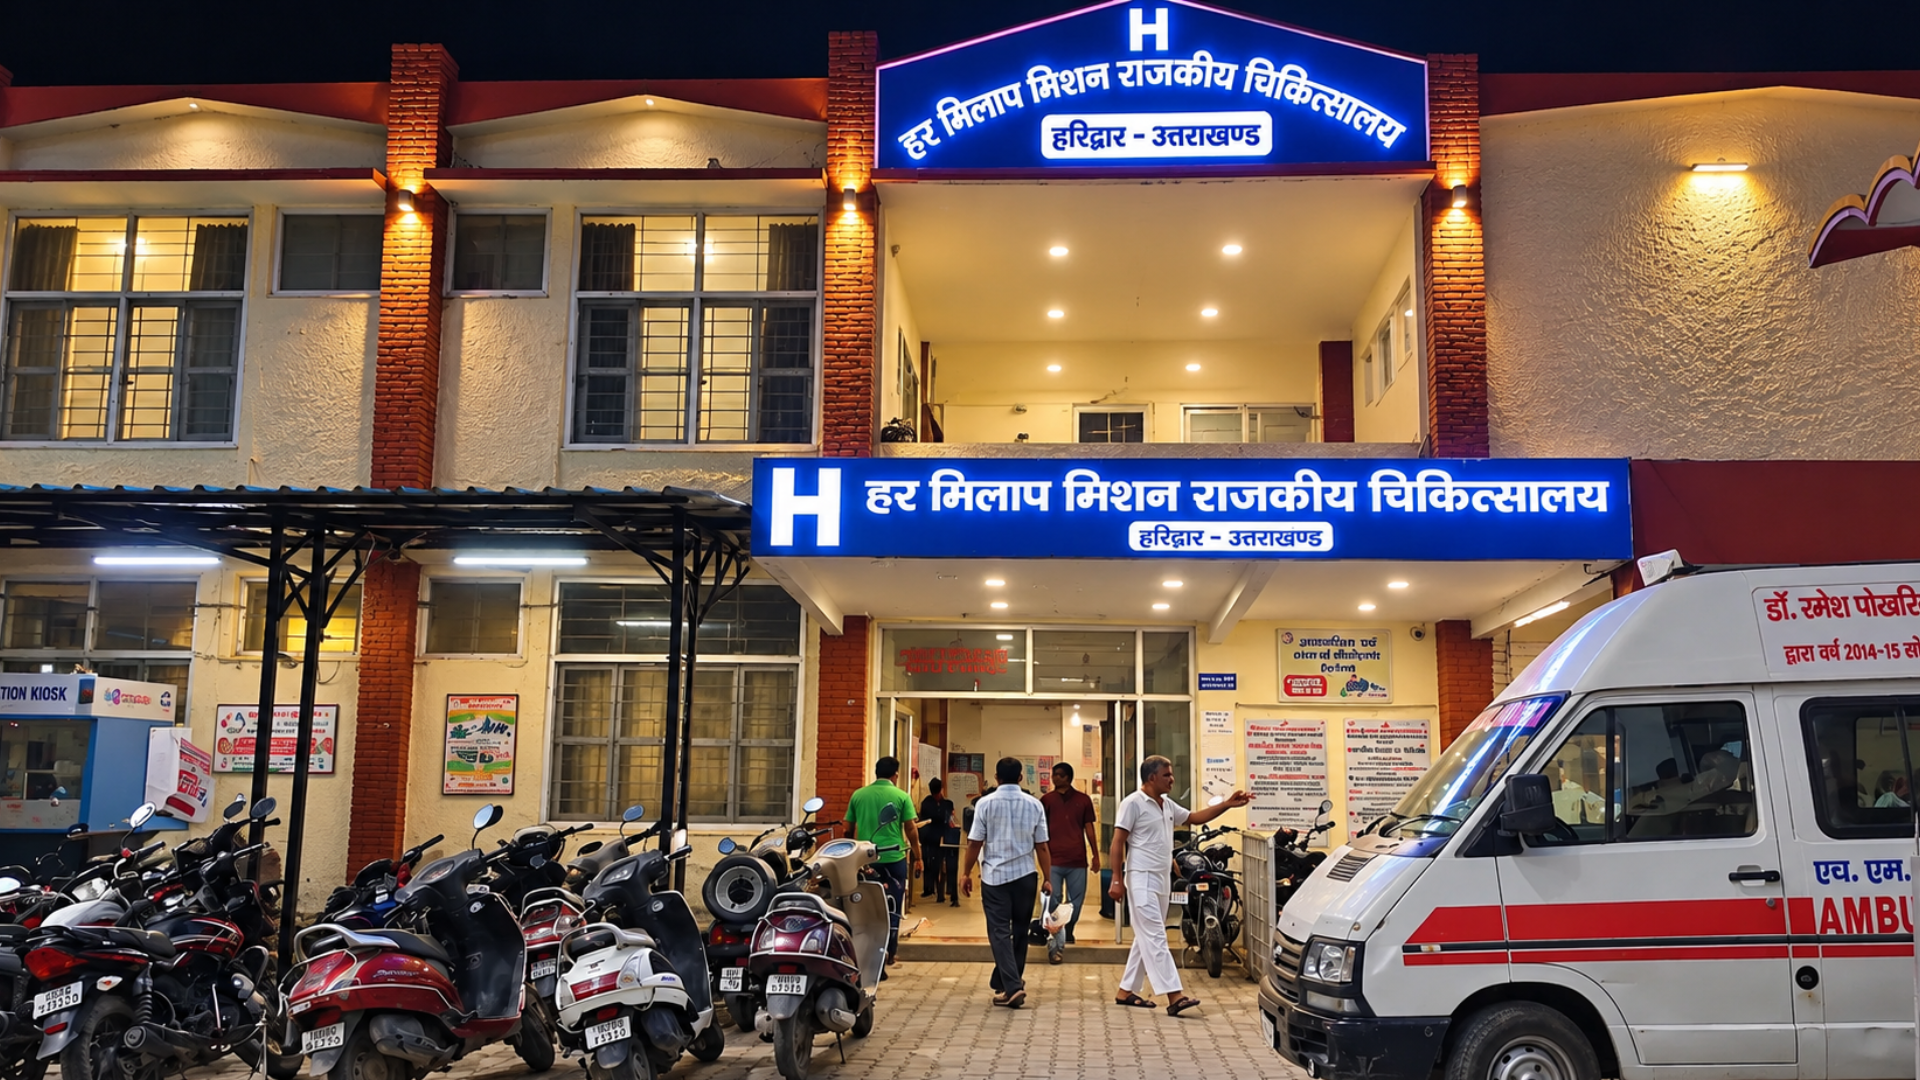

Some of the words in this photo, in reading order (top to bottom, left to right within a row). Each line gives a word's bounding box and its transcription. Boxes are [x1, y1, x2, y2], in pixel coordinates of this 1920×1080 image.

[1129, 8, 1169, 52] H
[897, 118, 941, 160] हर
[936, 96, 1024, 137] मिलाप
[1026, 63, 1110, 104] मिशन
[1115, 50, 1239, 91] राजकीय
[1243, 57, 1407, 149] चिकित्सालय
[1051, 119, 1127, 151] हरिद्वार
[1152, 124, 1262, 147] उत्तराखण्ड
[770, 467, 842, 547] H
[864, 480, 921, 514] हर
[928, 468, 1053, 512] मिलाप
[1062, 468, 1181, 512] मिशन
[1190, 468, 1358, 512] राजकीय
[1367, 468, 1610, 513] चिकित्सालय
[1139, 524, 1205, 549] हरिद्वार
[1229, 529, 1324, 547] उत्तराखण्ड
[1764, 590, 1797, 622] डॉ.
[1798, 588, 1851, 620] रमेश
[1853, 584, 1920, 618] पोखरि
[1783, 645, 1815, 665] द्वारा
[1844, 643, 1901, 661] 2014-15
[30, 686, 68, 701] KIOSK
[1813, 860, 1859, 885] एच.
[1864, 859, 1911, 884] एम.
[1819, 896, 1914, 934] AMBU
